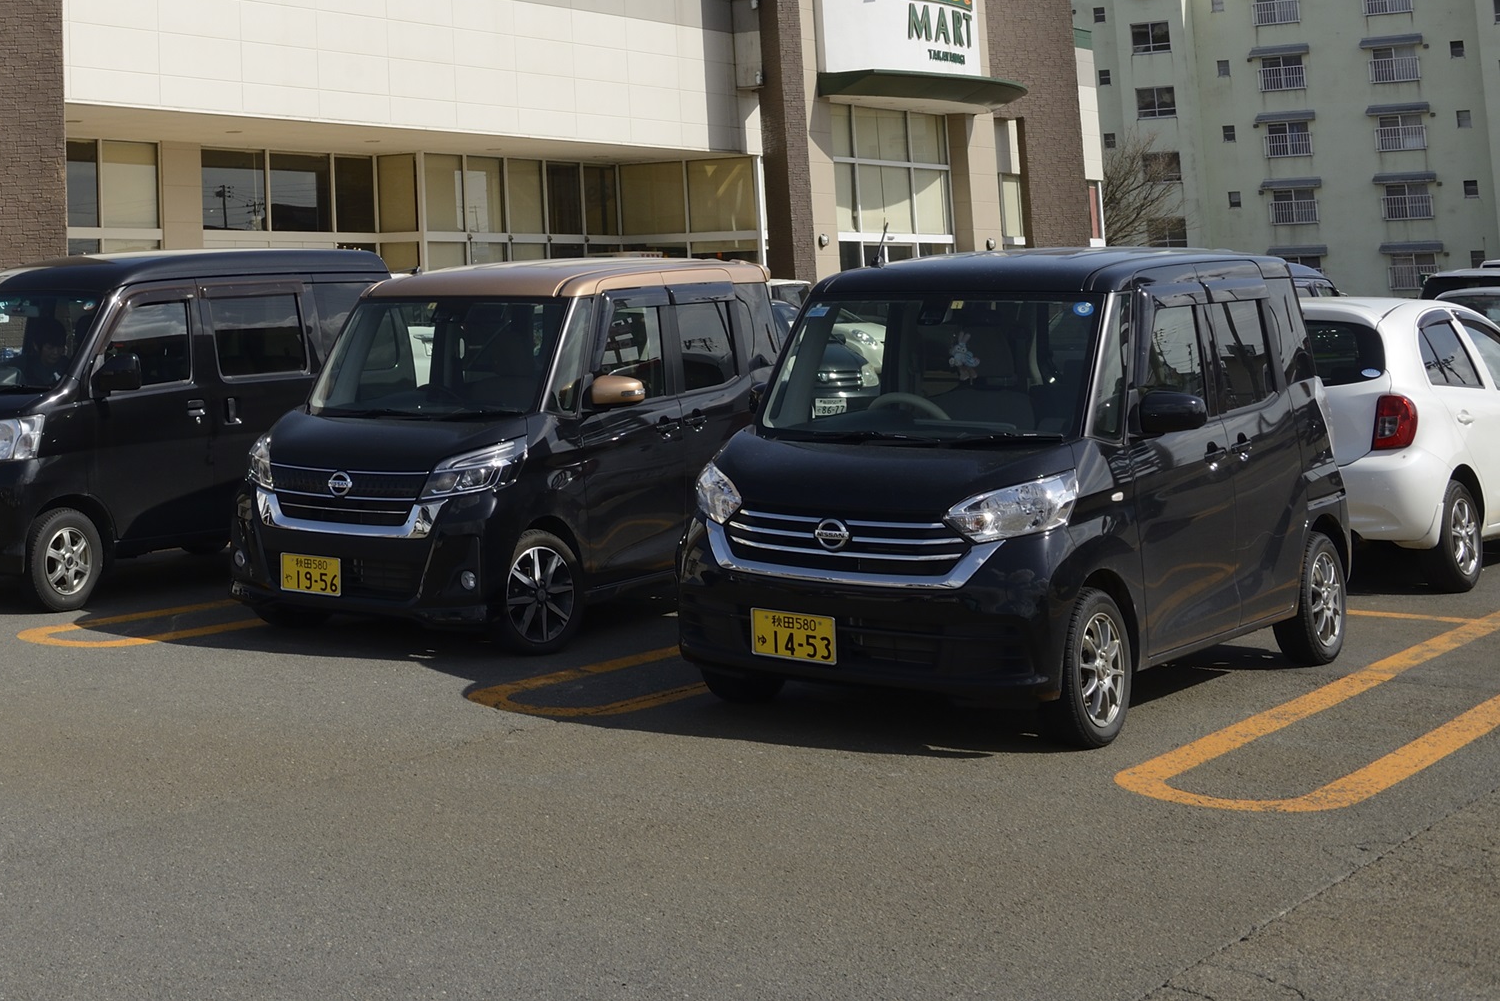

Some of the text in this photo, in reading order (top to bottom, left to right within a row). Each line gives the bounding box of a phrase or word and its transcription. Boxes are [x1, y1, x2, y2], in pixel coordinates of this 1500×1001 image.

[907, 3, 973, 49] MART
[821, 406, 845, 415] 86-77
[295, 558, 328, 570] 秋田580
[285, 570, 338, 592] や 19-56
[771, 615, 817, 632] 秋田580
[757, 630, 832, 660] ゆ 14-53
